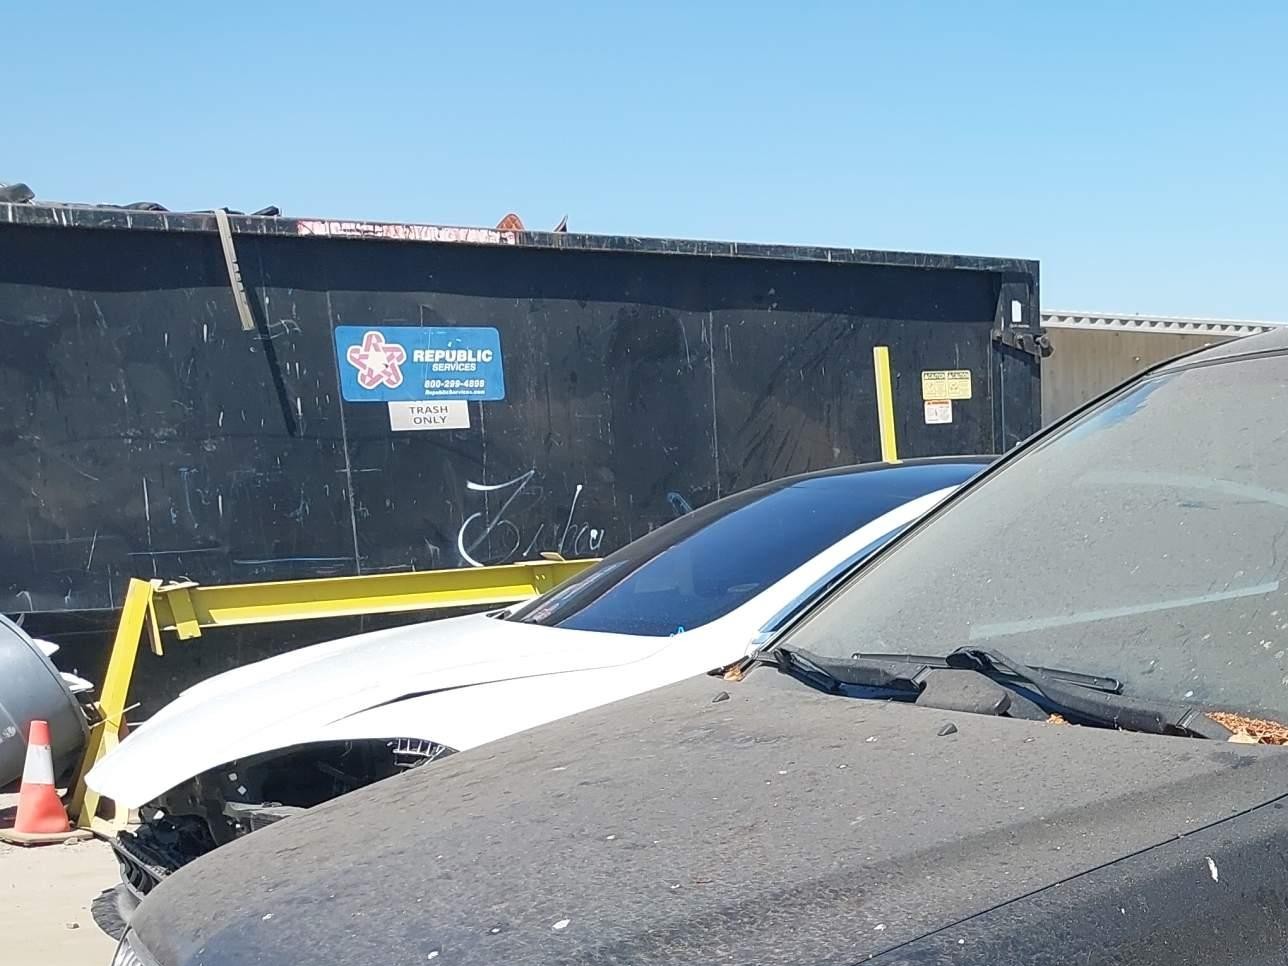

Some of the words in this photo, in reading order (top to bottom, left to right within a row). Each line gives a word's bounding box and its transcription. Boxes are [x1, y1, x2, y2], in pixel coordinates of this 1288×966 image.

[413, 349, 493, 363] REPUBLIC
[432, 362, 477, 372] SERVICES
[409, 405, 449, 414] TRASH
[413, 415, 448, 425] ONLY
